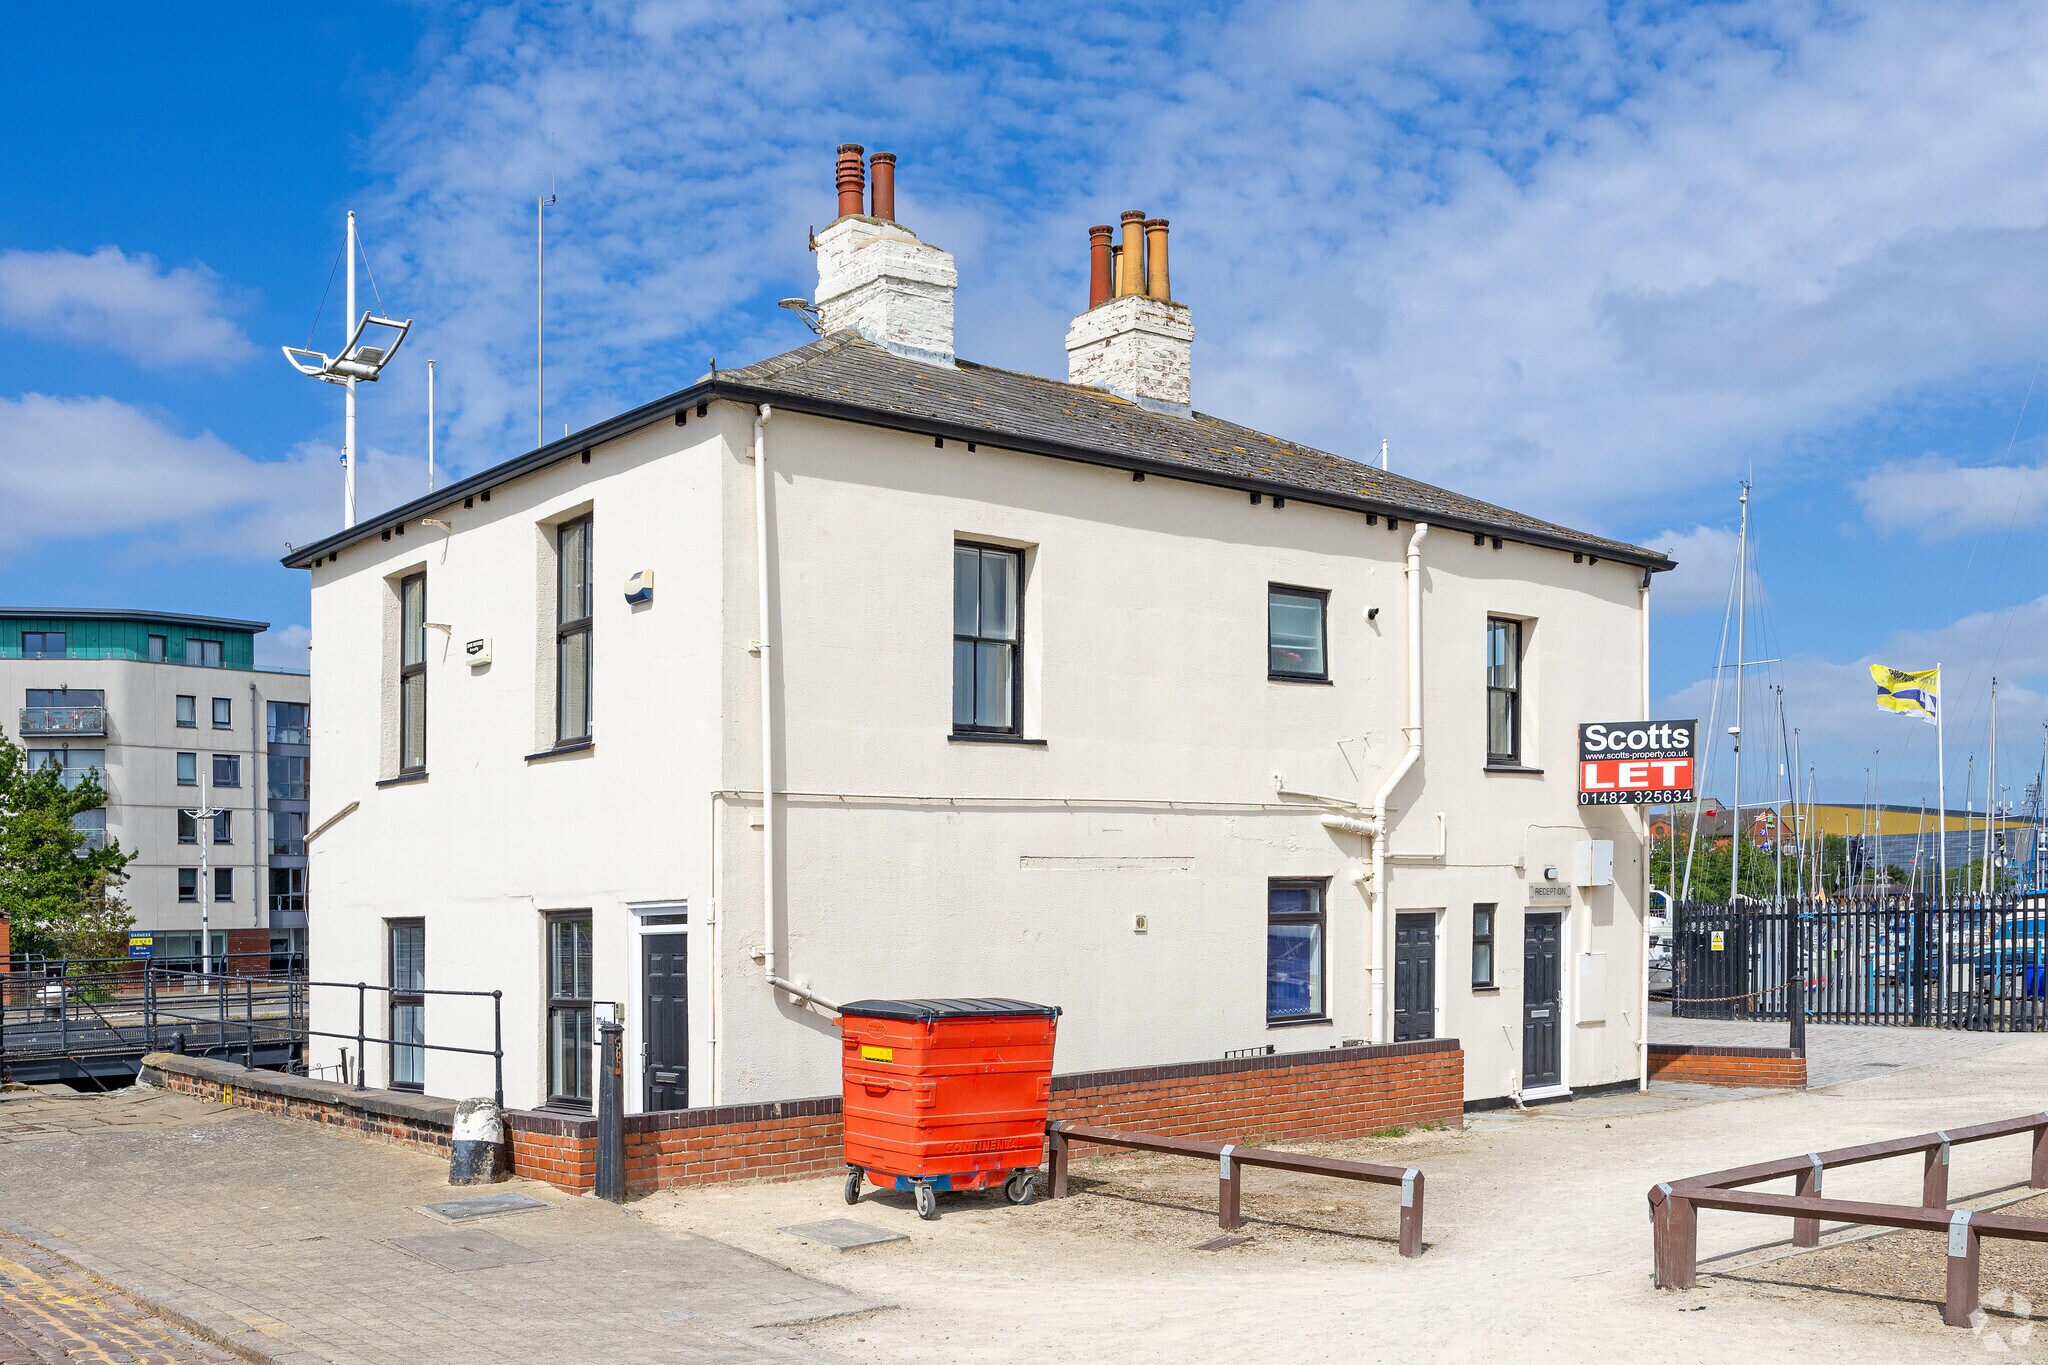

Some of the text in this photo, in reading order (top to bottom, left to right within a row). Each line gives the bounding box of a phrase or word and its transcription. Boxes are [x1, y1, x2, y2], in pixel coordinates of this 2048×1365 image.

[1584, 723, 1690, 751] Scotts
[1585, 749, 1689, 760] www.scotts-property.co.uk
[1585, 760, 1688, 789] LET
[1580, 789, 1692, 804] 01482 325634
[1535, 887, 1566, 896] RECEPTION
[946, 1137, 1024, 1153] CONTINENTAL
